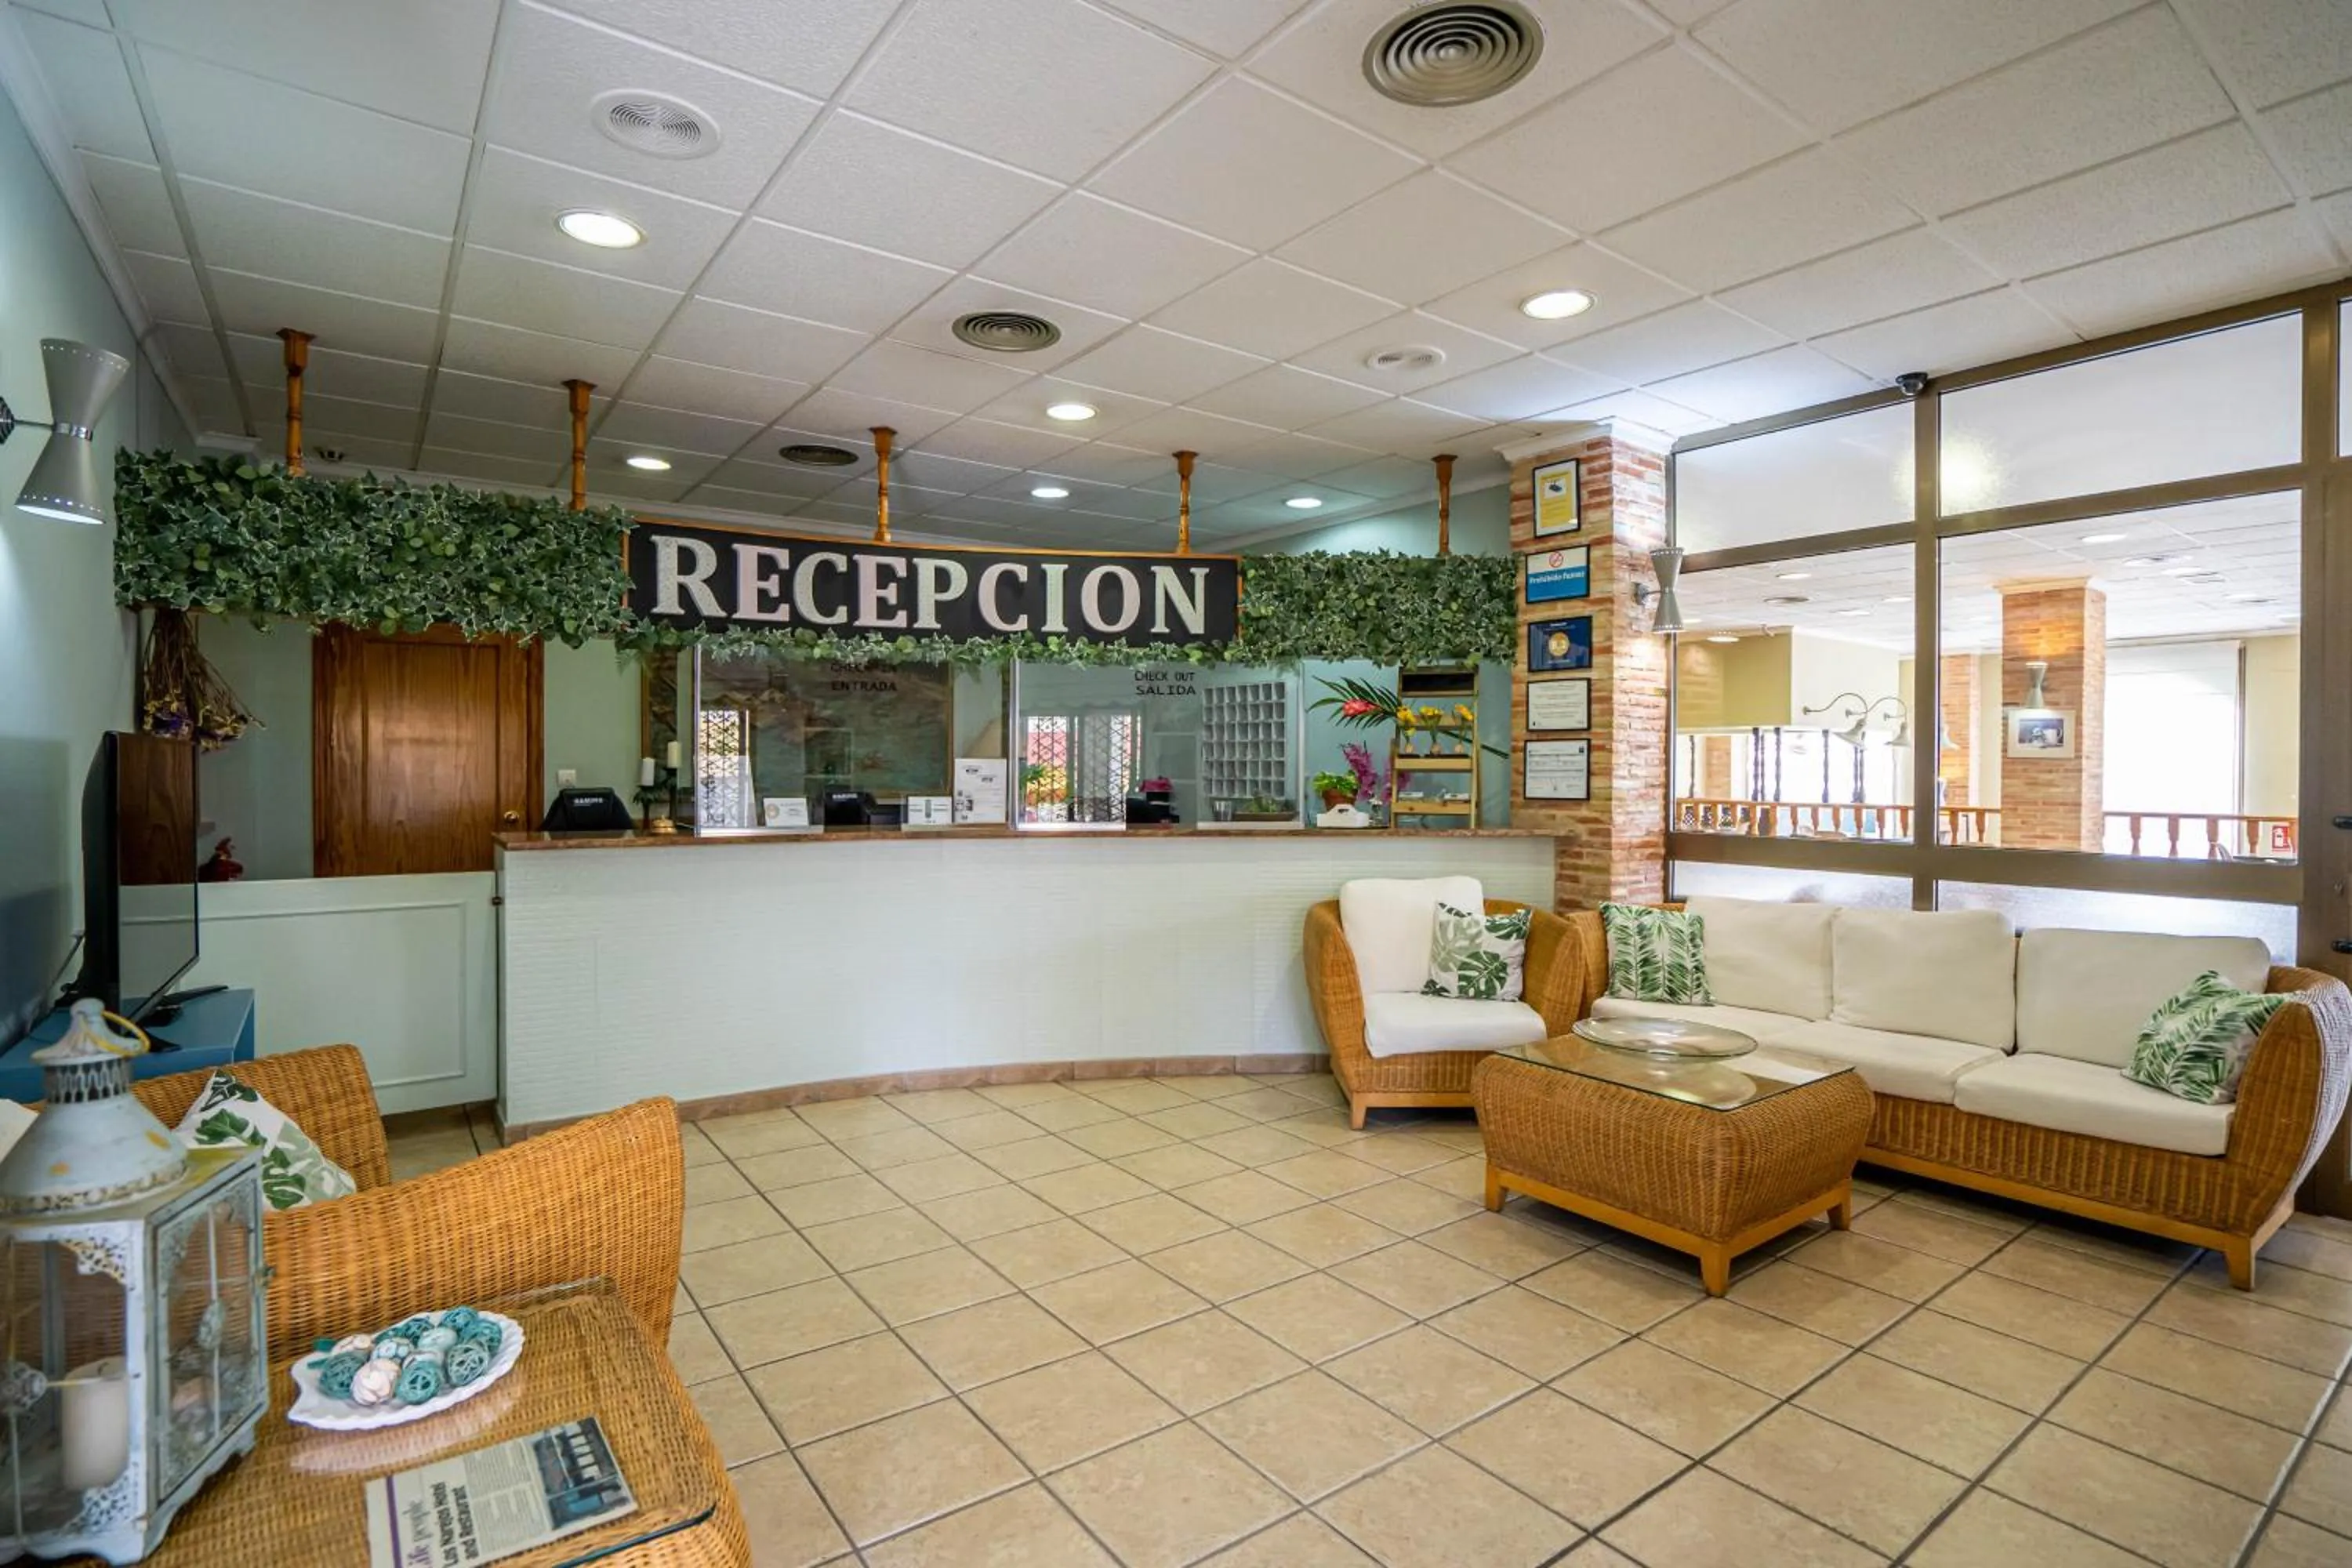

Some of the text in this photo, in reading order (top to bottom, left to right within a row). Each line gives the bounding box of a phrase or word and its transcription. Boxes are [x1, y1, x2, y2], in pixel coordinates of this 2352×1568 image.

[650, 534, 1210, 635] RECEPCION
[1134, 670, 1196, 681] CHECK OUT
[831, 681, 898, 691] ENTRADA
[1135, 684, 1196, 695] SALIDA
[429, 1481, 448, 1509] Hotel
[452, 1484, 480, 1560] and Restaurant
